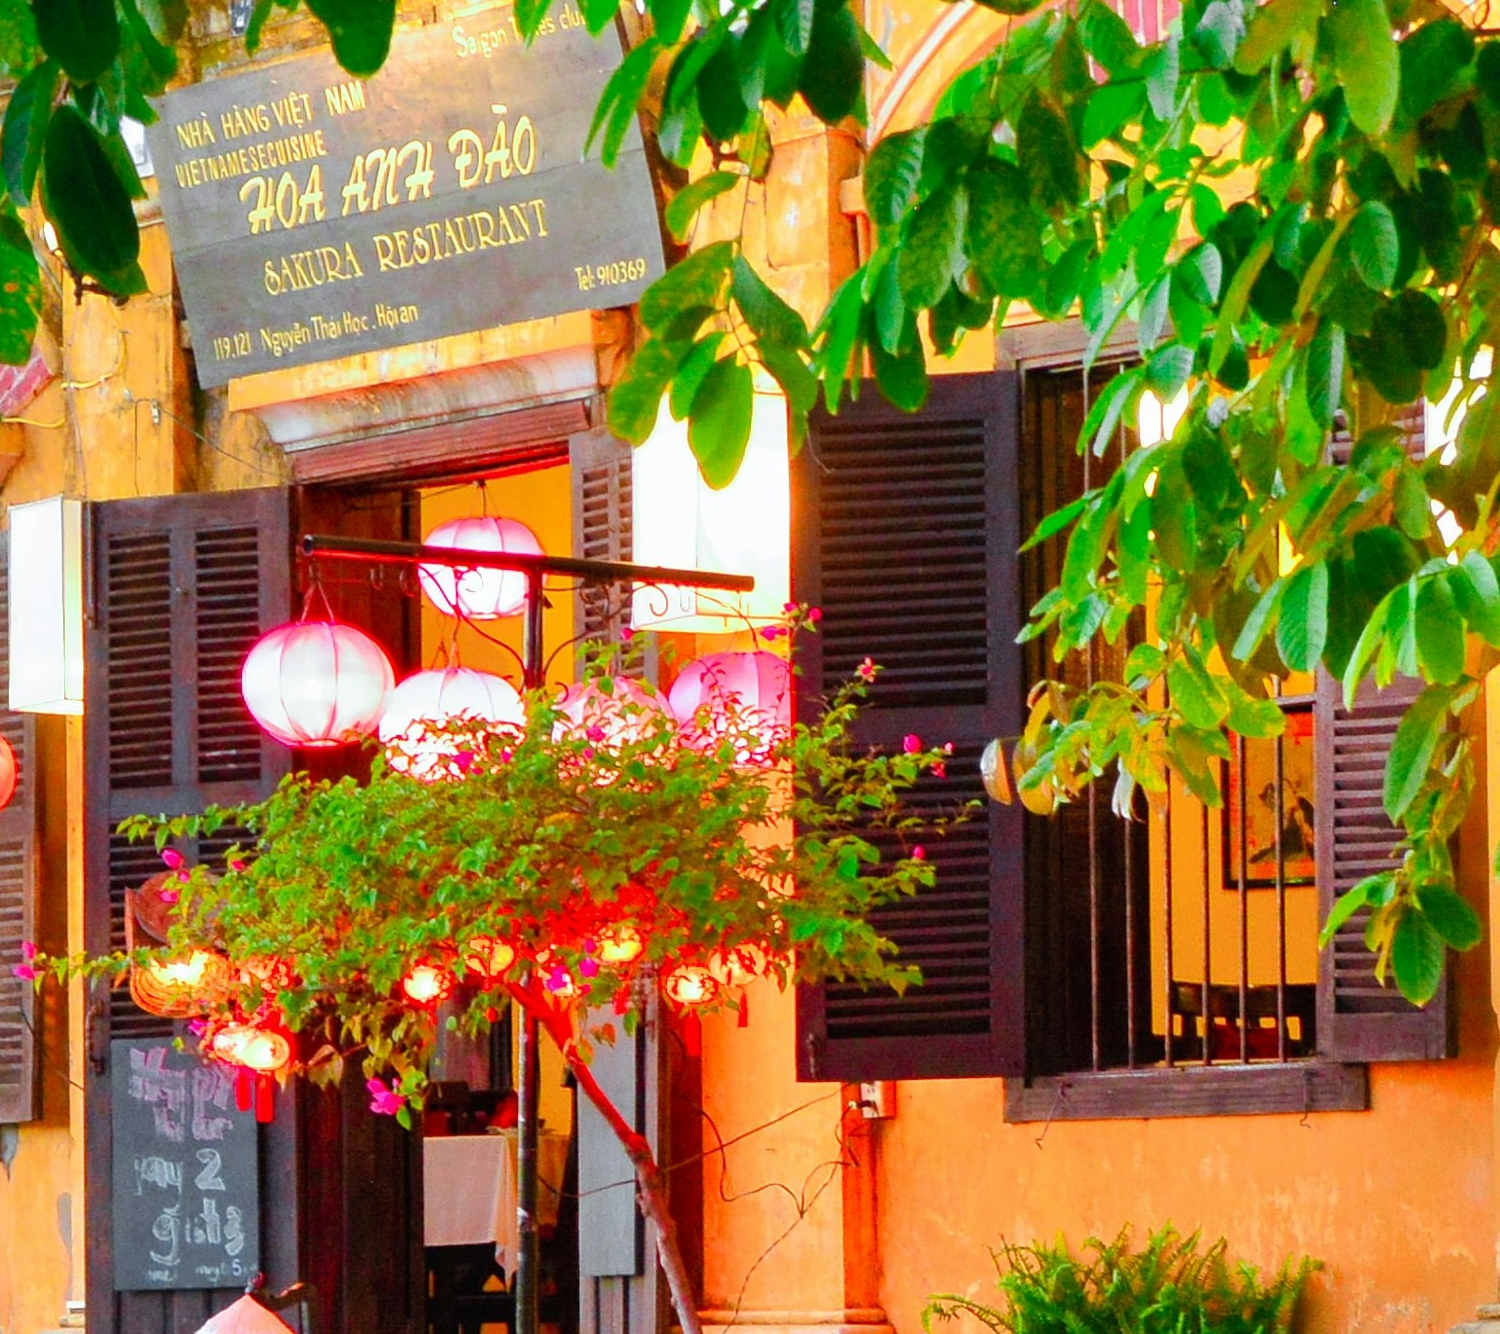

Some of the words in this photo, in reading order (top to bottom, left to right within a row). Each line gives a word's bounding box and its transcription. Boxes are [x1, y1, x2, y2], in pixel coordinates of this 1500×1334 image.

[452, 25, 508, 59] Saigon
[508, 15, 555, 42] Tes
[559, 3, 586, 30] clu
[176, 112, 216, 150] NHÀ
[221, 105, 270, 139] HÀNG
[271, 91, 314, 128] VIỆT
[325, 80, 366, 116] NAM
[239, 164, 327, 234] HOA
[341, 139, 434, 218] ANH
[448, 104, 536, 188] ĐÀO
[264, 242, 364, 296] SAKURA
[373, 198, 548, 272] RESTAURANT
[596, 258, 646, 286] 910369
[194, 1148, 226, 1191] 2
